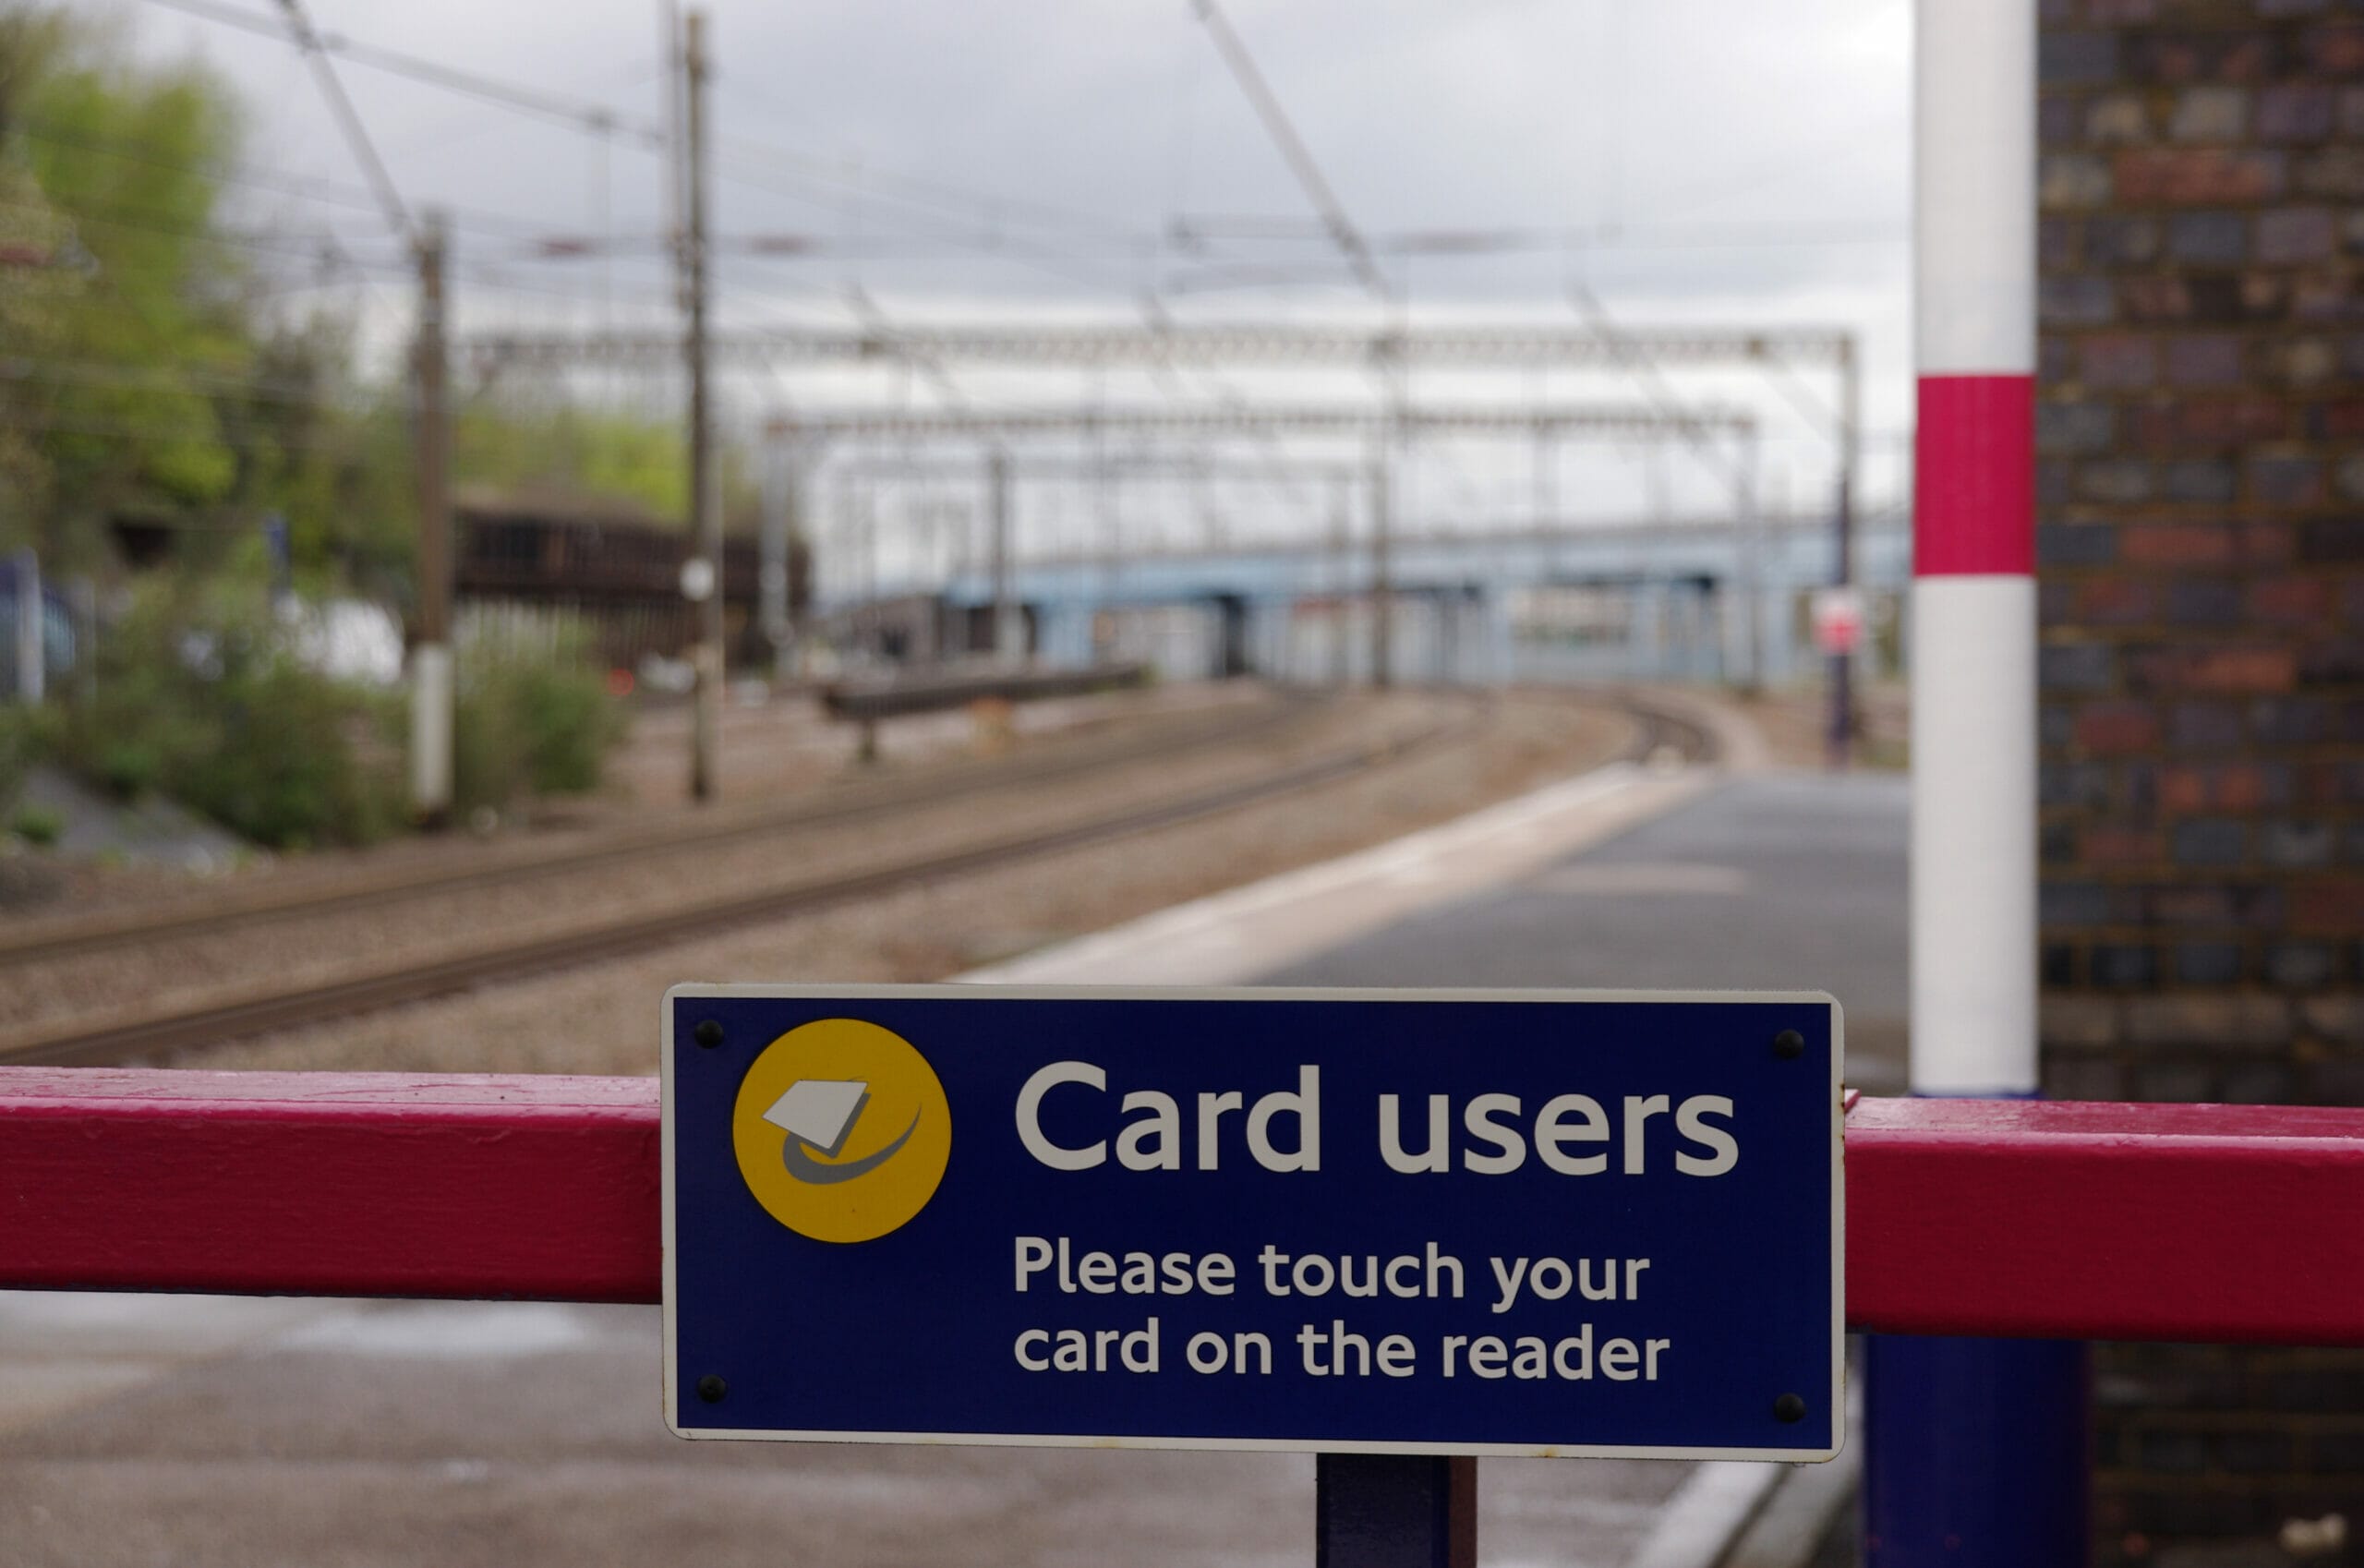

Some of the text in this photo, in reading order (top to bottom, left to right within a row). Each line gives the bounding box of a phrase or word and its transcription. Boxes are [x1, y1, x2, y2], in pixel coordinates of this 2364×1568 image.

[1015, 1061, 1739, 1176] Card users
[1015, 1236, 1650, 1313] Please touch your
[1014, 1317, 1670, 1381] card on the reader
